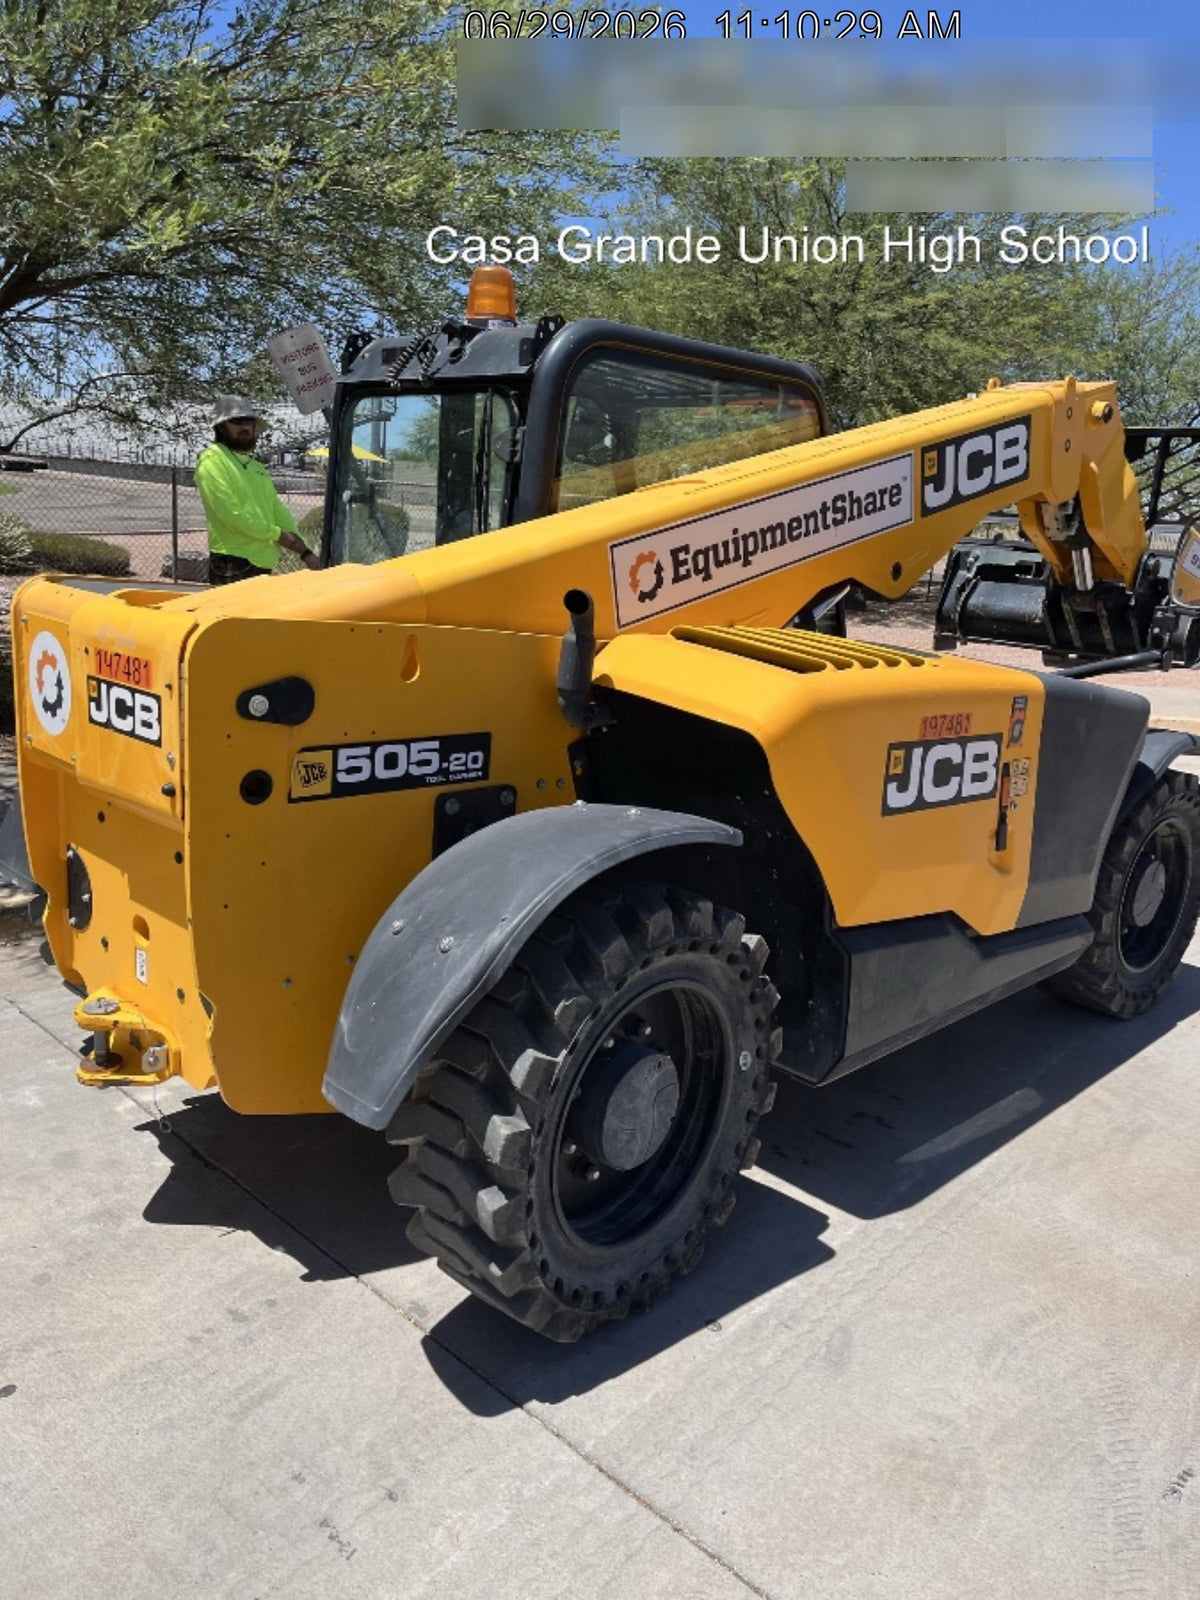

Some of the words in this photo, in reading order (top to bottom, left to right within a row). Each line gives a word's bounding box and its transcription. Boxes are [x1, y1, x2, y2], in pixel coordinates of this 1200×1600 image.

[924, 424, 1028, 508] JCB
[669, 482, 902, 584] EquipmentShare
[89, 682, 160, 741] JCB
[921, 713, 971, 739] 197481
[301, 763, 327, 786] JCB
[886, 740, 998, 808] JCB
